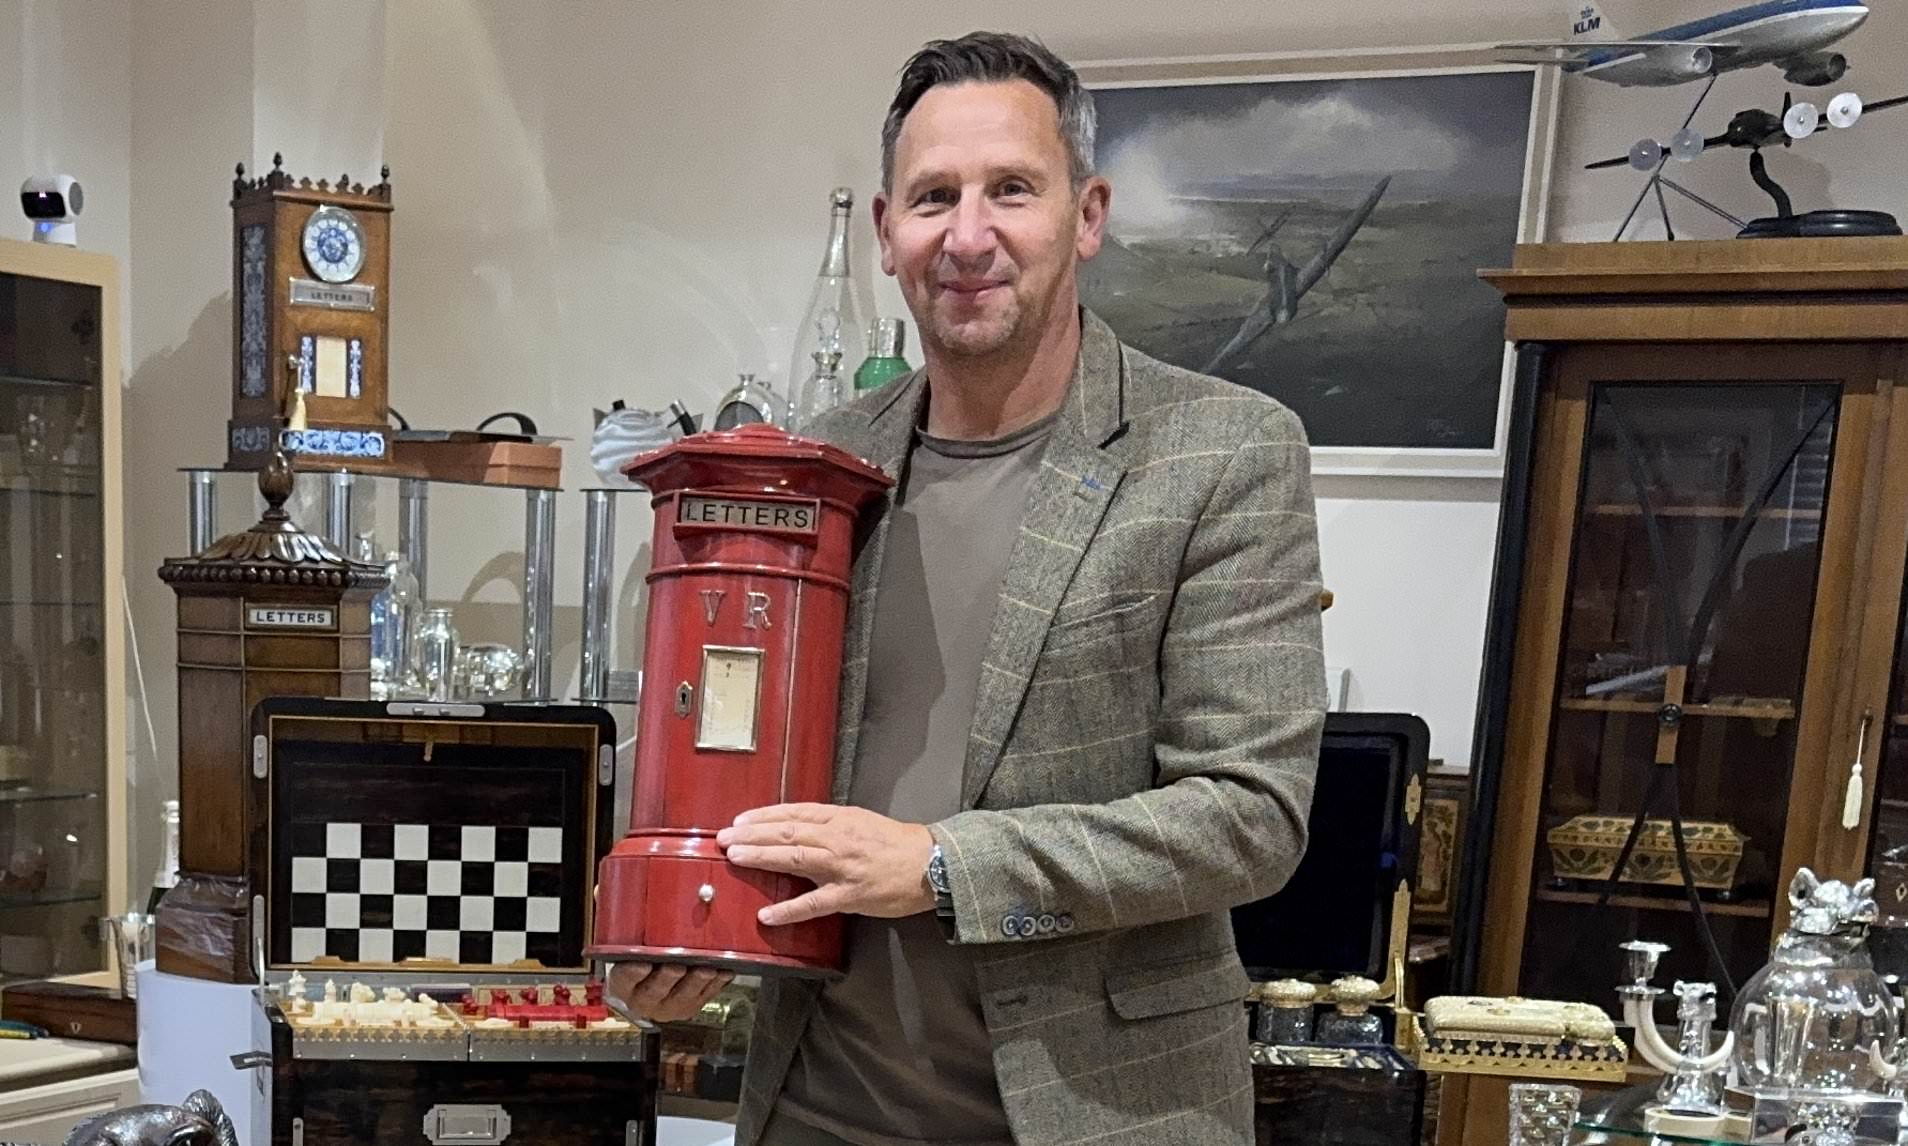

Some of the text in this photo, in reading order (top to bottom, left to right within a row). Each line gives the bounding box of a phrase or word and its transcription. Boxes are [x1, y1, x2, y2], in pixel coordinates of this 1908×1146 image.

[1573, 16, 1601, 35] KLM
[686, 503, 809, 528] LETTERS
[256, 610, 325, 623] LETTERS
[700, 590, 773, 631] V R
